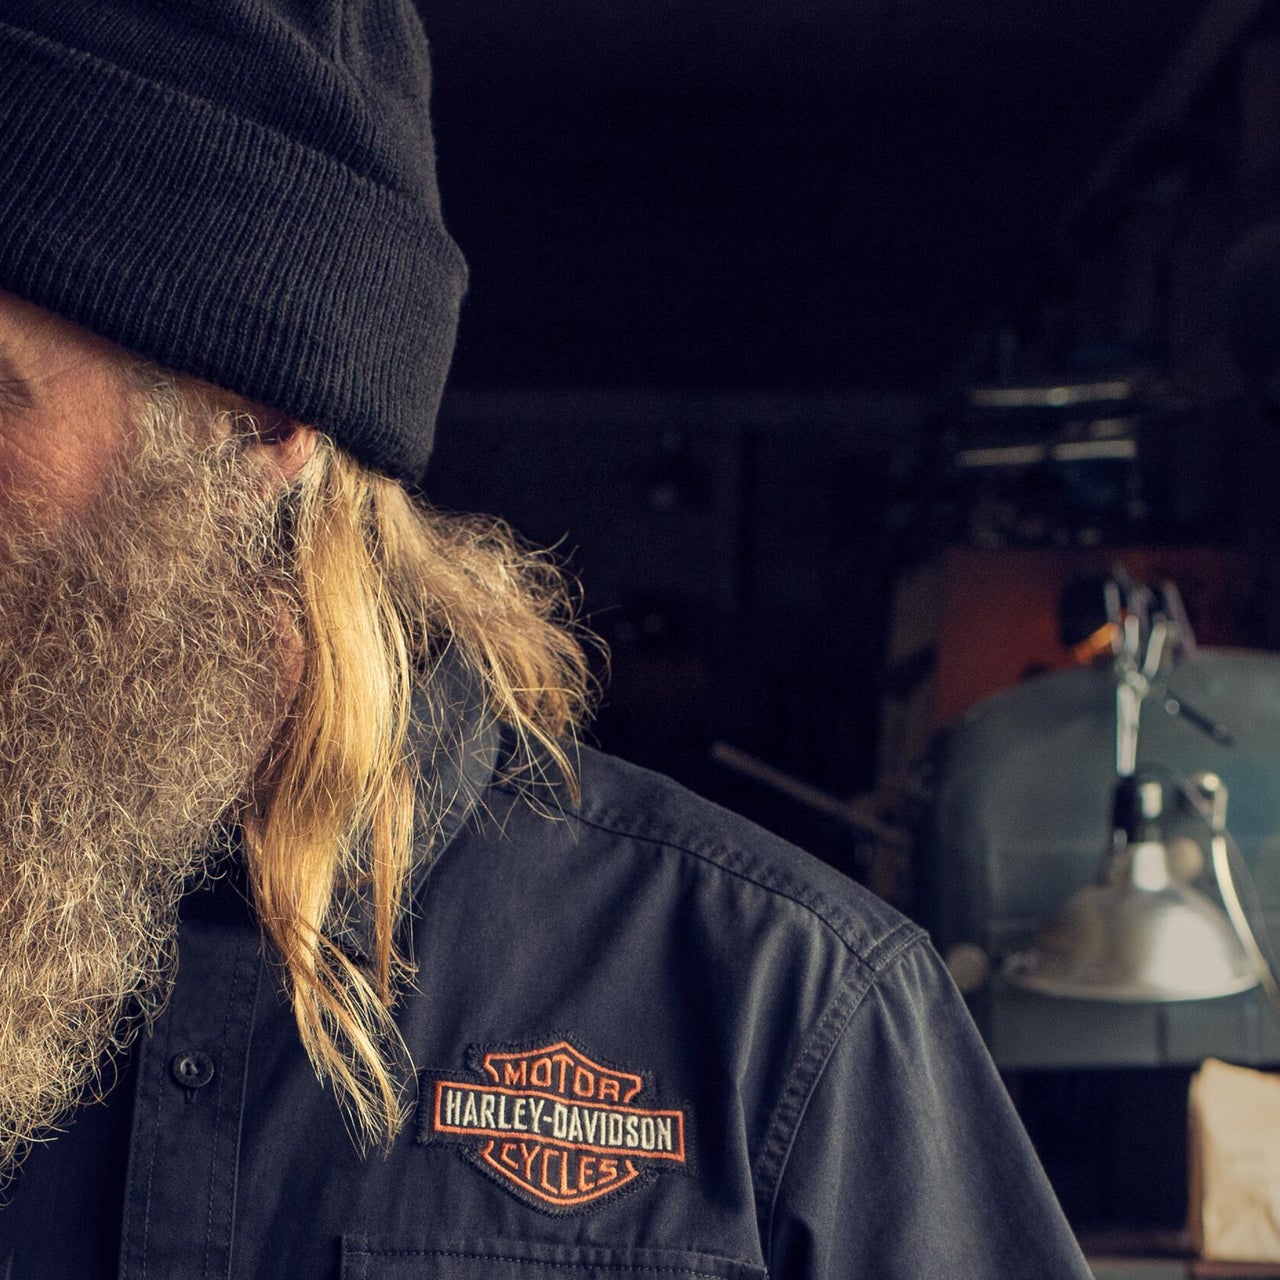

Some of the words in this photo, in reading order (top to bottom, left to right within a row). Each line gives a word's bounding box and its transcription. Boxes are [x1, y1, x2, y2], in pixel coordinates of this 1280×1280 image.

[503, 1053, 621, 1102] MOTOR
[445, 1089, 672, 1151] HARLEY-DAVIDSON
[499, 1142, 618, 1196] CYCLES
